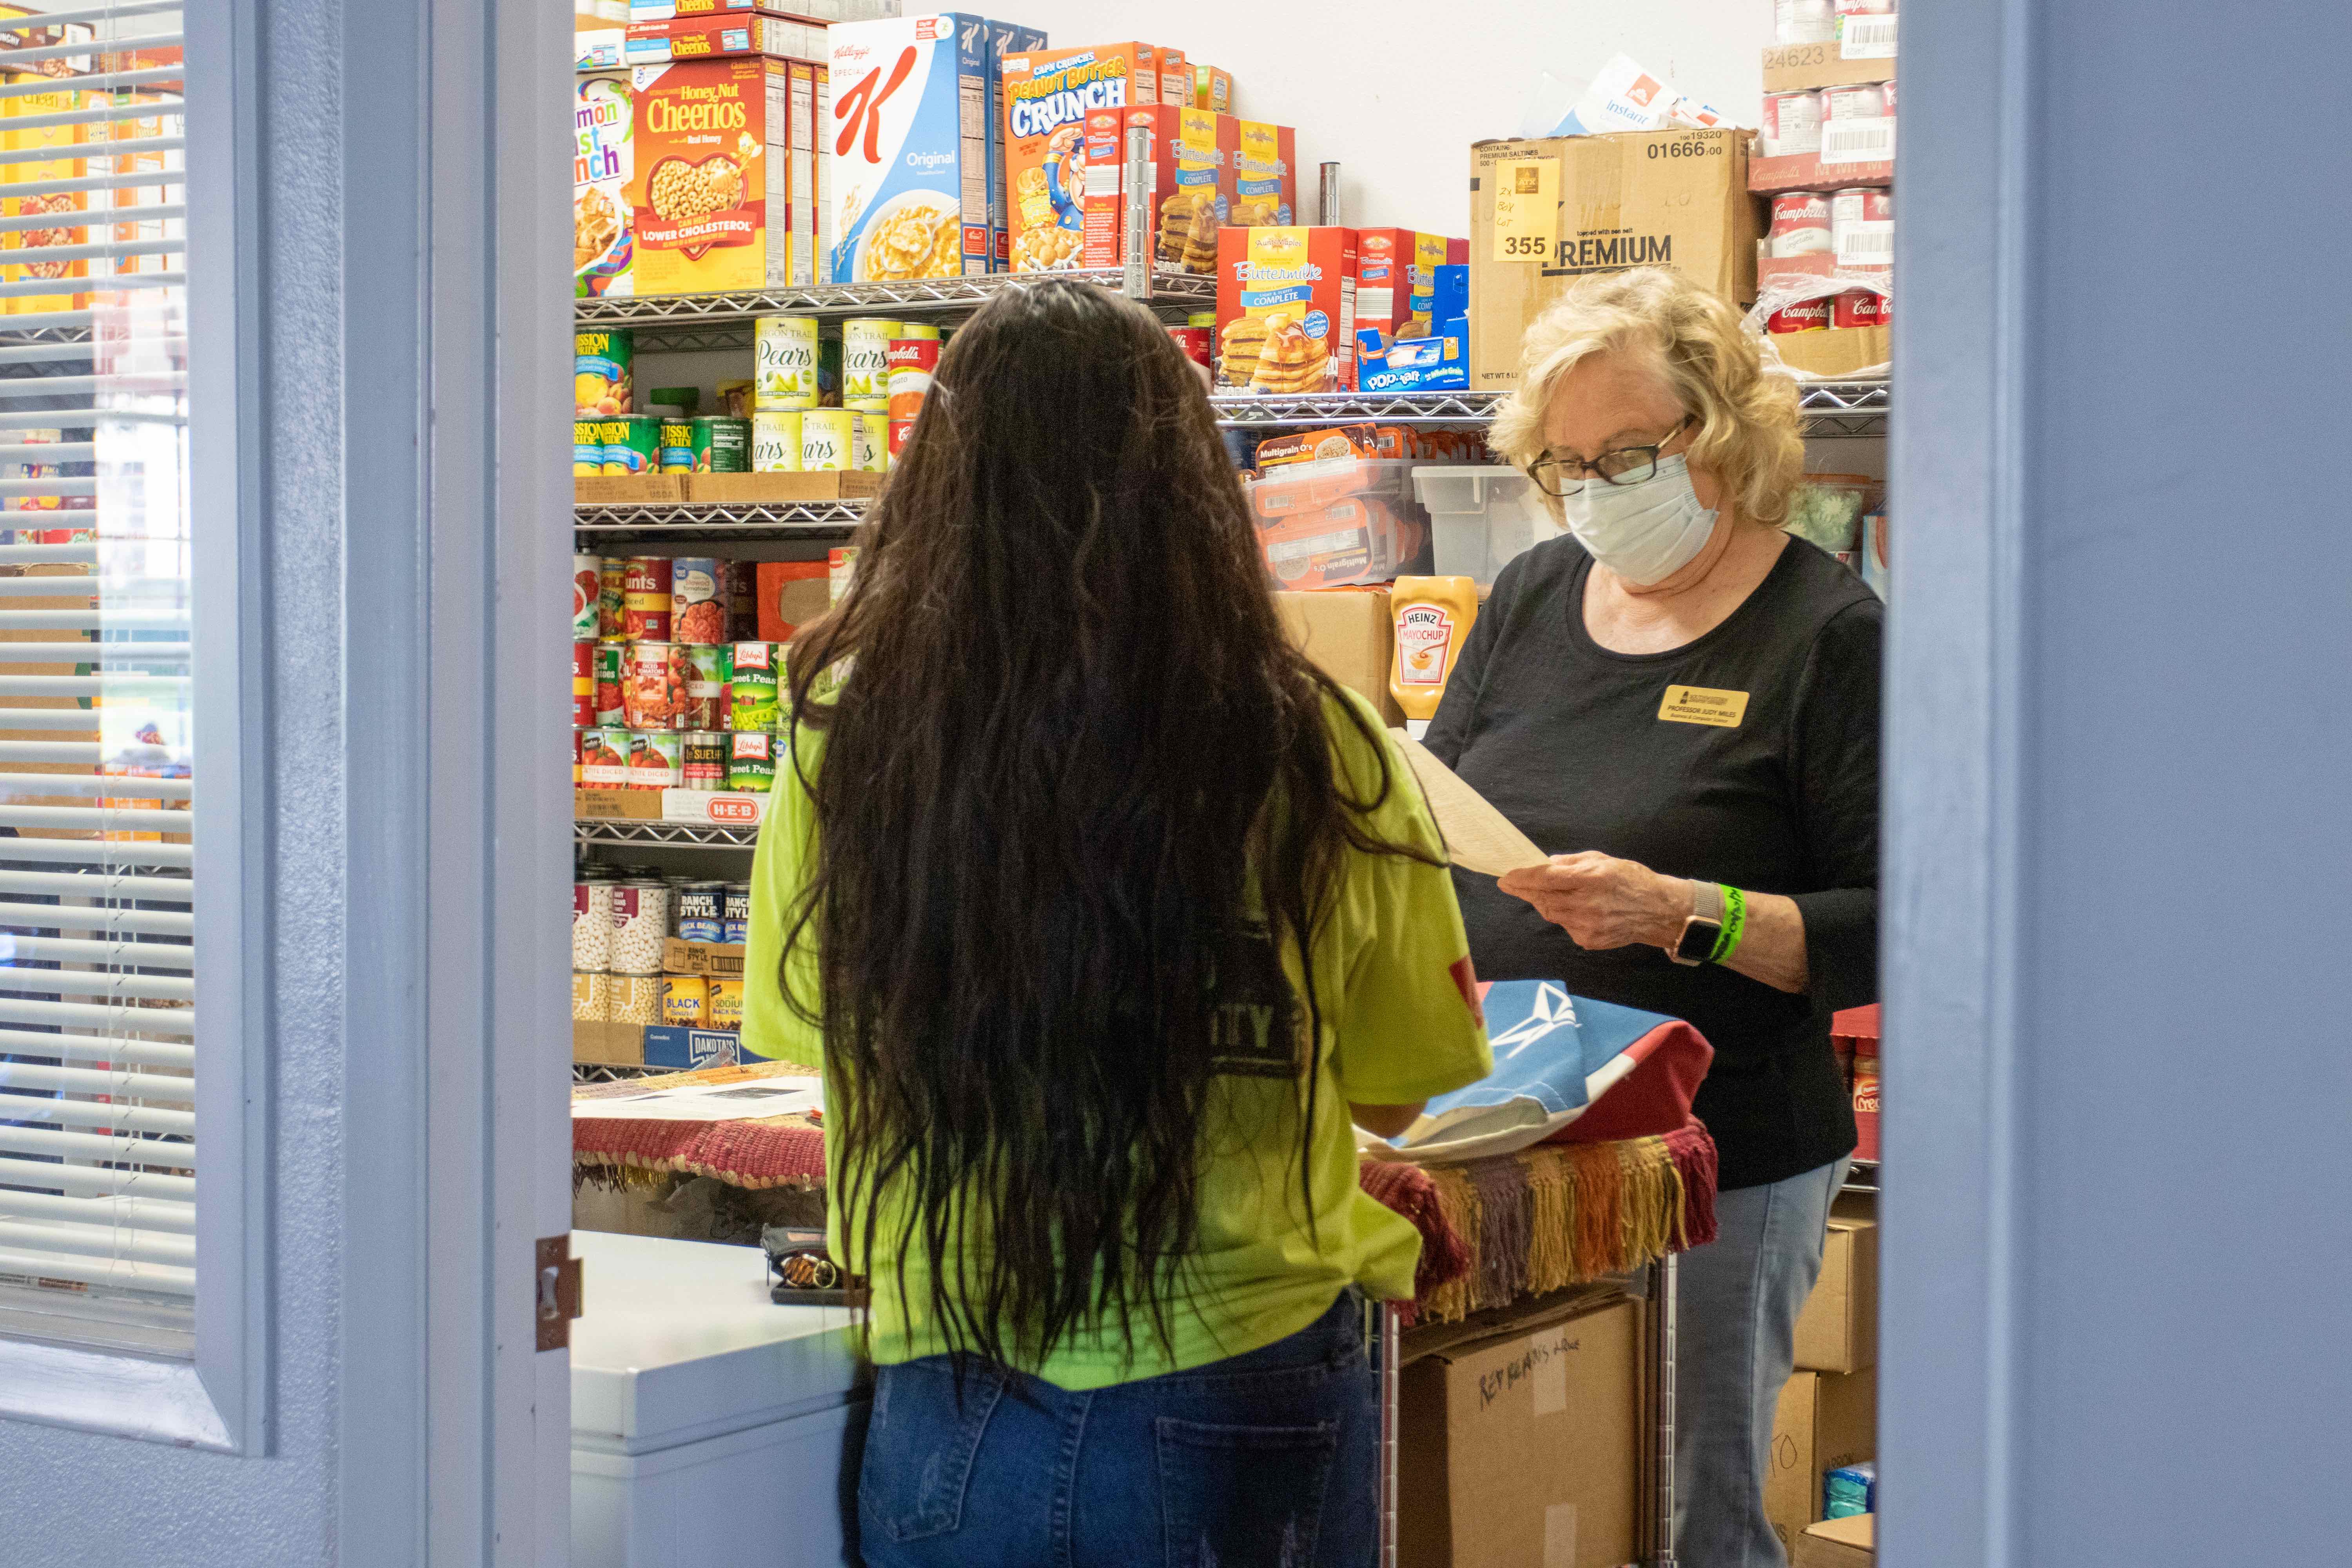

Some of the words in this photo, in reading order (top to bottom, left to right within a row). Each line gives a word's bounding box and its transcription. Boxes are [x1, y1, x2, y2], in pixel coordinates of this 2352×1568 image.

[961, 24, 980, 53] K
[671, 41, 711, 56] Cheerios
[834, 44, 871, 60] Kellogg's
[1764, 45, 1824, 69] 24623
[834, 68, 865, 77] SPECIAL
[1008, 71, 1066, 107] PEANUT
[1066, 56, 1127, 89] BUTTER
[681, 85, 716, 102] Honey
[718, 83, 739, 98] Nut
[835, 45, 918, 164] K
[1011, 78, 1127, 137] CRUNCH
[1606, 99, 1650, 125] Instant
[577, 102, 617, 128] mon
[647, 96, 746, 133] Cheerios
[688, 135, 702, 144] Real
[702, 135, 722, 144] Honey
[1691, 131, 1722, 140] 19320
[1170, 139, 1225, 165] Buttermilk
[575, 144, 620, 183] nch
[906, 151, 955, 169] Original
[1233, 151, 1287, 176] Buttermilk
[1184, 174, 1212, 184] COMPLETE
[1246, 185, 1274, 194] COMPLETE
[678, 219, 691, 227] CAN
[693, 214, 711, 224] HELP
[642, 230, 677, 241] LOWER
[1255, 240, 1274, 249] Aunt
[1505, 237, 1545, 255] 355
[1233, 261, 1322, 281] Buttermilk
[1406, 264, 1434, 287] Butte
[1254, 292, 1298, 306] COMPLETE
[790, 329, 813, 338] TRAIL
[576, 334, 609, 352] ISSION
[757, 339, 813, 371] Pears
[1430, 368, 1448, 379] Whole
[1448, 366, 1464, 376] Grain
[574, 422, 604, 440] SSION
[574, 435, 597, 445] RIDE
[754, 441, 786, 460] ars
[804, 441, 837, 459] ars
[1260, 445, 1299, 458] Multigrain
[1300, 443, 1313, 452] O's
[1328, 556, 1367, 570] Multigrain
[1408, 613, 1437, 624] HEINZ
[1403, 630, 1444, 640] MAYOCHUP
[740, 648, 762, 662] Libby's
[753, 674, 777, 684] Peas
[1668, 705, 1701, 714] PROFESSOR
[738, 740, 762, 753] Libby's
[681, 895, 713, 906] RANCH
[680, 906, 717, 918] STYLE
[725, 907, 749, 918] STYL
[697, 922, 720, 933] BEANS
[667, 998, 700, 1008] BLACK
[695, 1037, 736, 1057] DAKOTA'S
